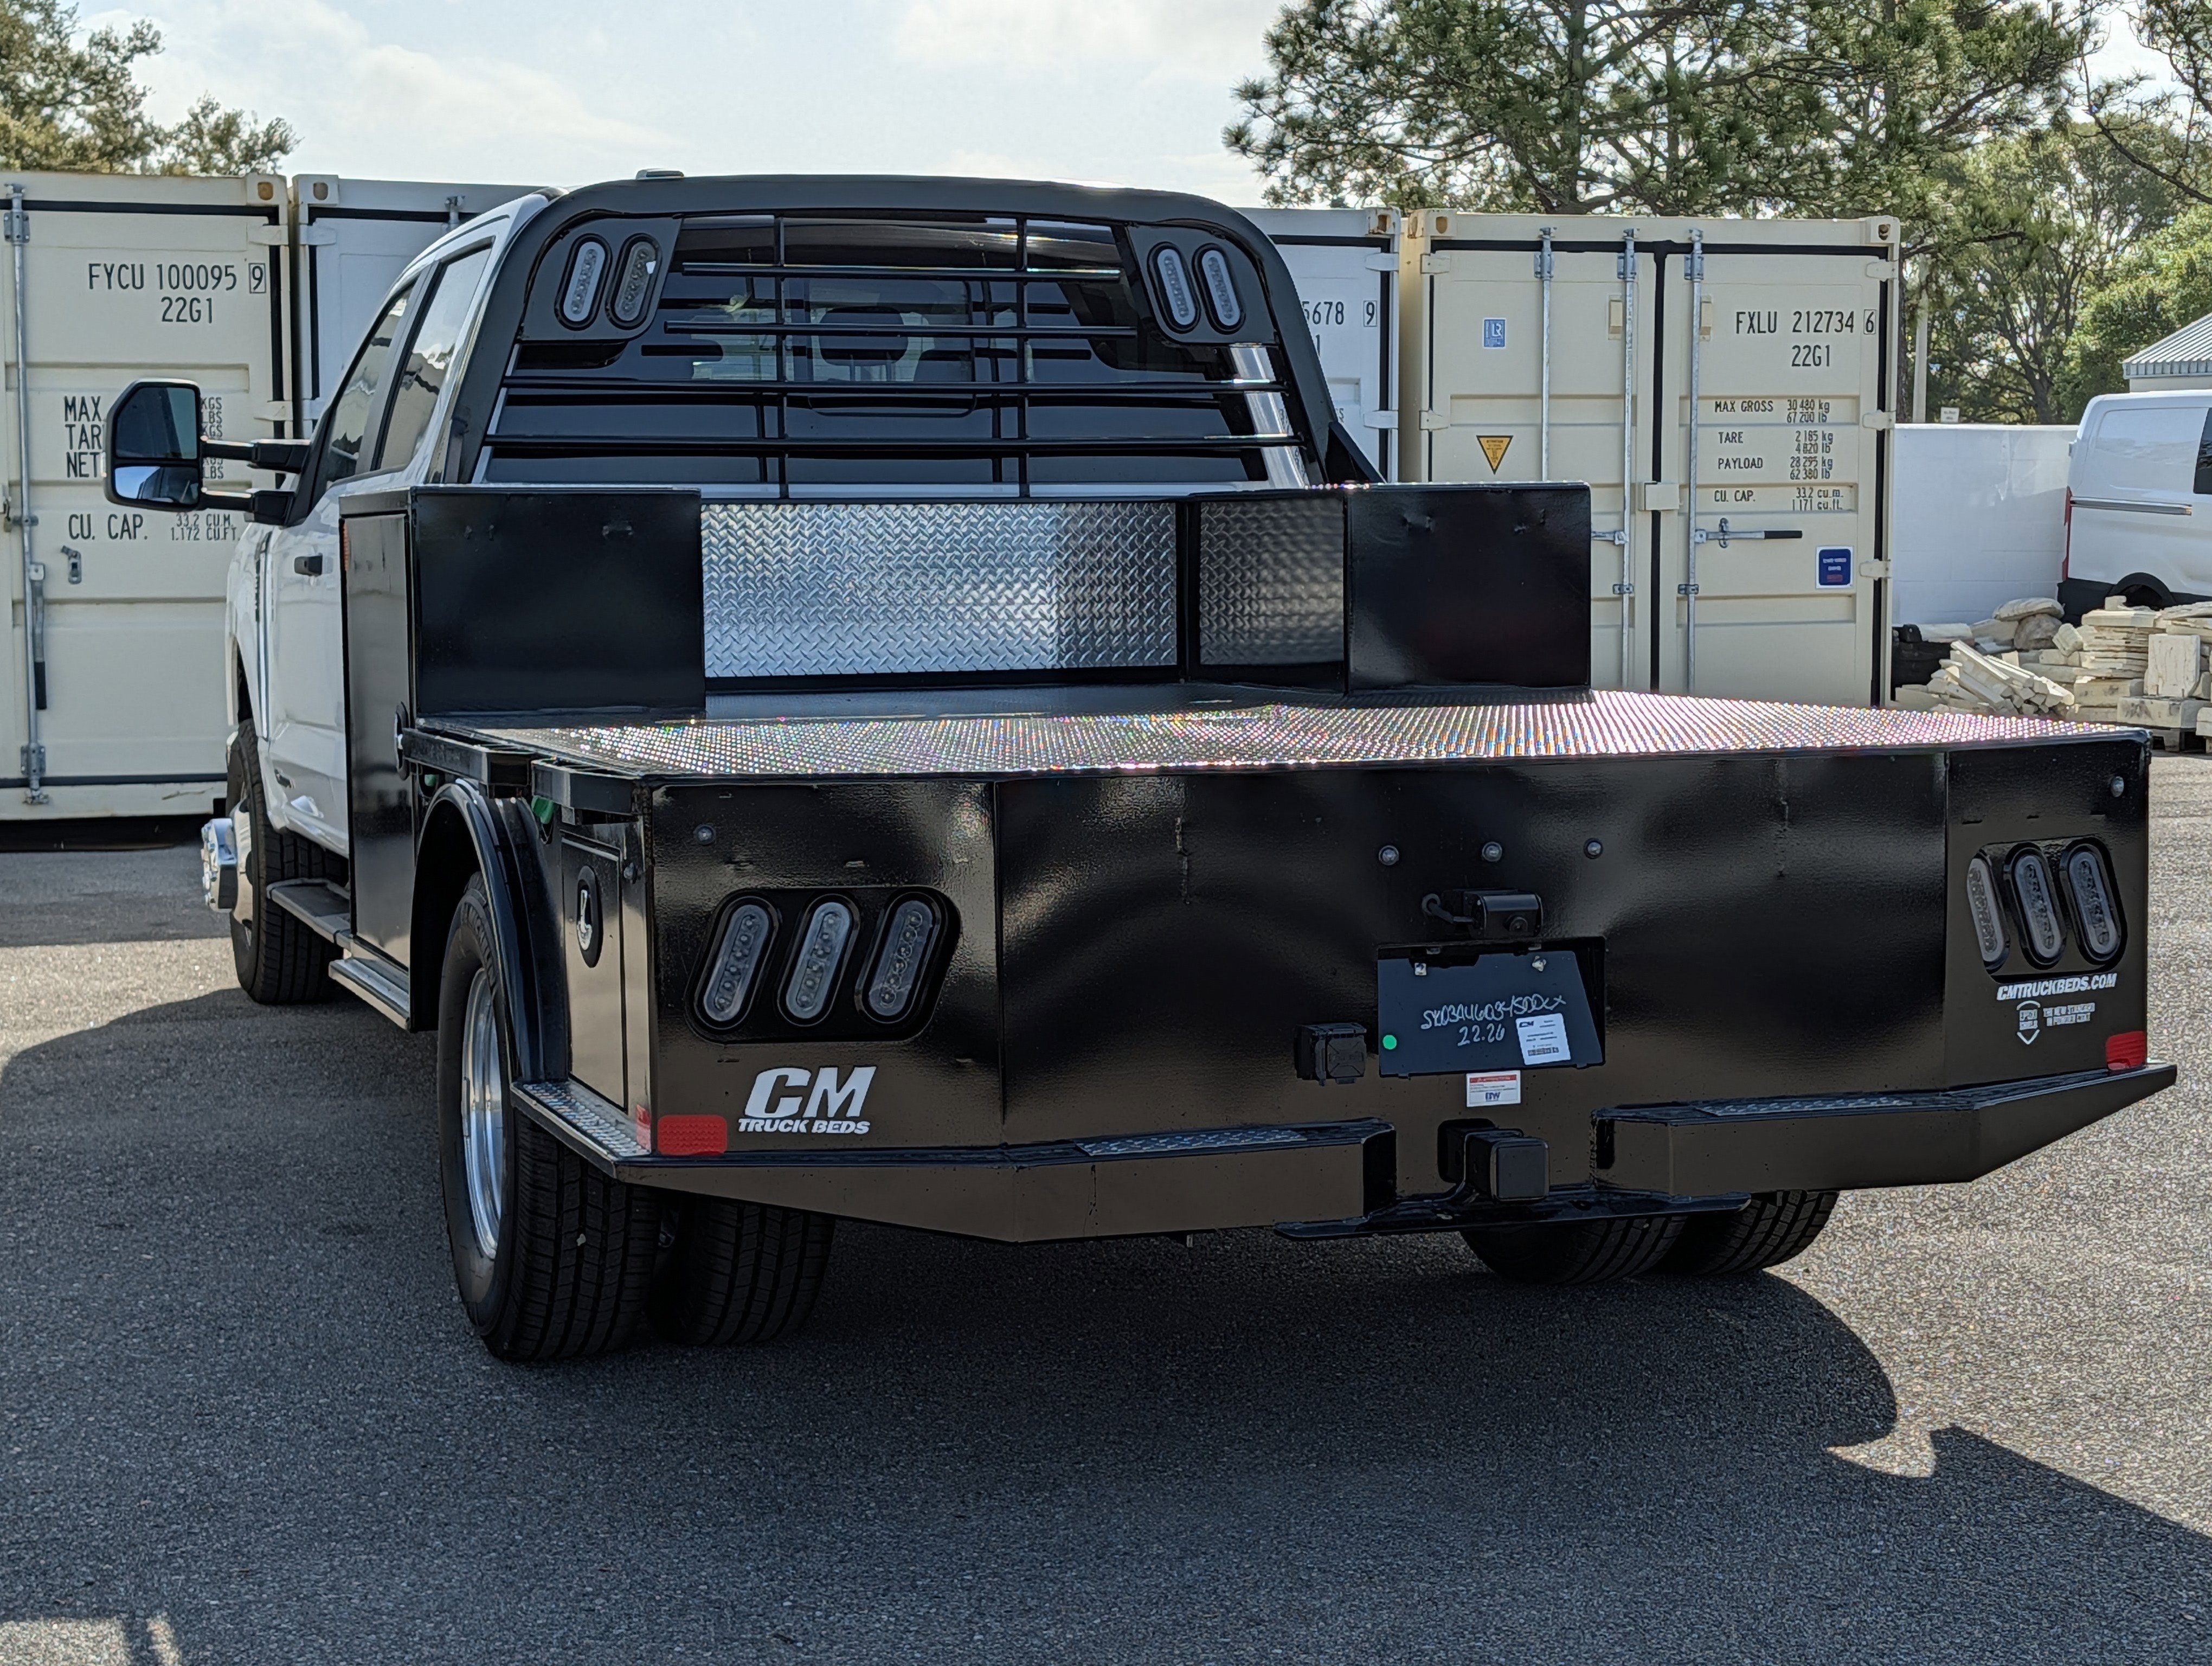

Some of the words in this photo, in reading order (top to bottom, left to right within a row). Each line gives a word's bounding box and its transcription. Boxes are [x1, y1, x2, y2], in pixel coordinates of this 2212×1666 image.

[88, 263, 144, 290] FYCU
[157, 264, 237, 291] 100095
[250, 265, 265, 292] 9
[161, 296, 213, 324] 22G1
[1365, 301, 1376, 326] 9
[1736, 311, 1777, 334] FXLU
[1792, 310, 1854, 334] 212734
[1864, 310, 1875, 334] 6
[1791, 344, 1830, 367] 22G1
[64, 395, 102, 422] MAX
[1714, 401, 1735, 413] MAX
[1741, 400, 1774, 412] GROSS
[1818, 399, 1830, 413] kg
[1818, 412, 1827, 422] lb
[65, 424, 105, 450] TAR
[1718, 431, 1744, 444] TARE
[1822, 430, 1833, 445] kg
[1822, 442, 1830, 453] lb
[66, 451, 100, 478] NET
[1718, 457, 1763, 469] PAYLOAD
[1822, 456, 1833, 470] kg
[1822, 467, 1830, 479] lb
[1714, 490, 1728, 502] CU.
[1734, 490, 1756, 502] CAP.
[68, 513, 95, 540] CU.
[107, 513, 147, 540] CAP.
[1996, 973, 2118, 1001] CMTRUCKBEDS.COM
[744, 1066, 877, 1119] CM
[738, 1118, 809, 1133] TRUCK
[811, 1119, 871, 1134] BEDS
